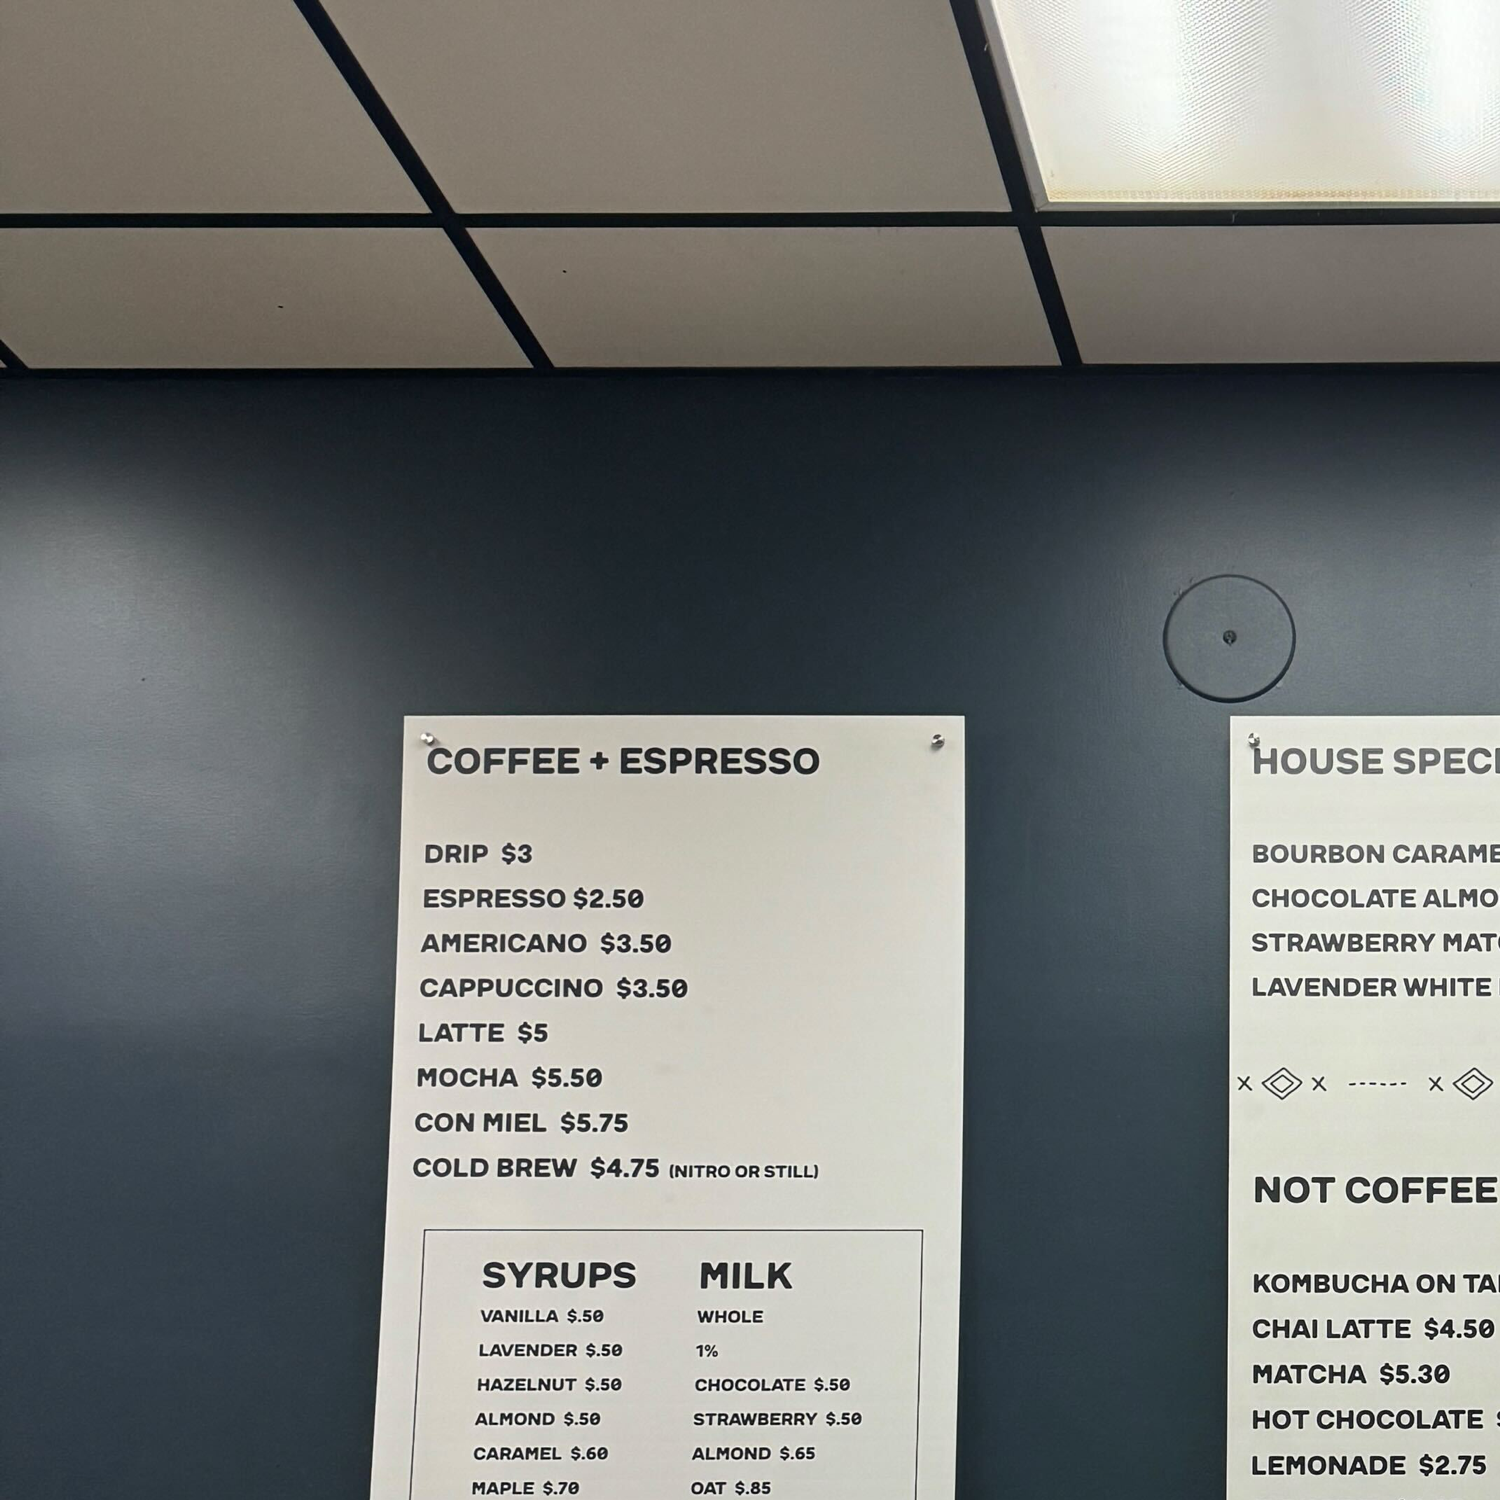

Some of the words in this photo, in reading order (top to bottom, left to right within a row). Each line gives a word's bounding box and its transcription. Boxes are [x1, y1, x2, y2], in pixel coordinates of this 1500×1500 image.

[427, 746, 582, 775] COFFEE
[589, 751, 610, 770] +
[620, 746, 820, 775] ESPRESSO
[1252, 746, 1384, 775] HOUSE
[424, 844, 489, 864] DRIP
[501, 842, 533, 866] $3
[1252, 844, 1385, 864] BOURBON
[423, 888, 566, 909] ESPRESSO
[573, 886, 644, 911] $2.50
[1252, 888, 1417, 908] CHOCOLATE
[420, 933, 587, 953] AMERICANO
[600, 931, 672, 955] $3.50
[1251, 932, 1436, 953] STRAWBERRY
[419, 977, 604, 998] CAPPUCCINO
[616, 976, 688, 1000] $3.50
[1252, 977, 1397, 997] LAVENDER
[1402, 977, 1492, 997] WHITE
[418, 1022, 505, 1043] LATTE
[517, 1021, 548, 1045] $5
[417, 1067, 519, 1088] MOCHA
[531, 1066, 603, 1090] $5.50
[414, 1112, 475, 1133] CON
[483, 1112, 547, 1133] MIEL
[560, 1111, 629, 1135] $5.75
[412, 1157, 489, 1178] COLD
[496, 1157, 578, 1178] BREW
[590, 1156, 660, 1180] $4.75
[669, 1163, 731, 1179] (NITRO
[734, 1165, 761, 1179] OR
[764, 1164, 819, 1180] STILL)
[1254, 1176, 1336, 1204] NOT
[1345, 1176, 1498, 1204] COFFEE
[482, 1261, 636, 1289] SYRUPS
[700, 1262, 793, 1290] MILK
[1253, 1273, 1410, 1294] KOMBUCHA
[1416, 1273, 1456, 1294] ON
[480, 1309, 559, 1323] VANILLA
[567, 1308, 604, 1324] $.50
[697, 1310, 764, 1324] WHOLE
[1252, 1318, 1318, 1339] CHAI
[1326, 1319, 1412, 1339] LATTE
[1424, 1317, 1495, 1341] $4.50
[479, 1343, 578, 1357] LAVENDER
[585, 1342, 623, 1359] $.50
[695, 1344, 719, 1358] 1%
[477, 1377, 578, 1392] HAZELNUT
[584, 1376, 622, 1393] $.50
[1252, 1364, 1367, 1385] MATCHA
[1379, 1362, 1451, 1386] $5.30
[694, 1378, 806, 1392] CHOCOLATE
[814, 1377, 851, 1393] $.50
[474, 1412, 556, 1426] ALMOND
[563, 1411, 601, 1427] $.50
[693, 1412, 818, 1426] STRAWBERRY
[825, 1411, 862, 1427] $.50
[1252, 1409, 1310, 1430] HOT
[1316, 1409, 1484, 1430] CHOCOLATE
[473, 1446, 562, 1461] CARAMEL
[570, 1445, 609, 1462] $.60
[691, 1446, 772, 1461] ALMOND
[779, 1445, 816, 1462] $.65
[1252, 1455, 1407, 1476] LEMONADE
[1419, 1453, 1487, 1477] $2.75
[471, 1481, 535, 1496] MAPLE
[542, 1480, 580, 1496] $.70
[690, 1481, 727, 1495] OAT
[734, 1480, 771, 1496] $.85
